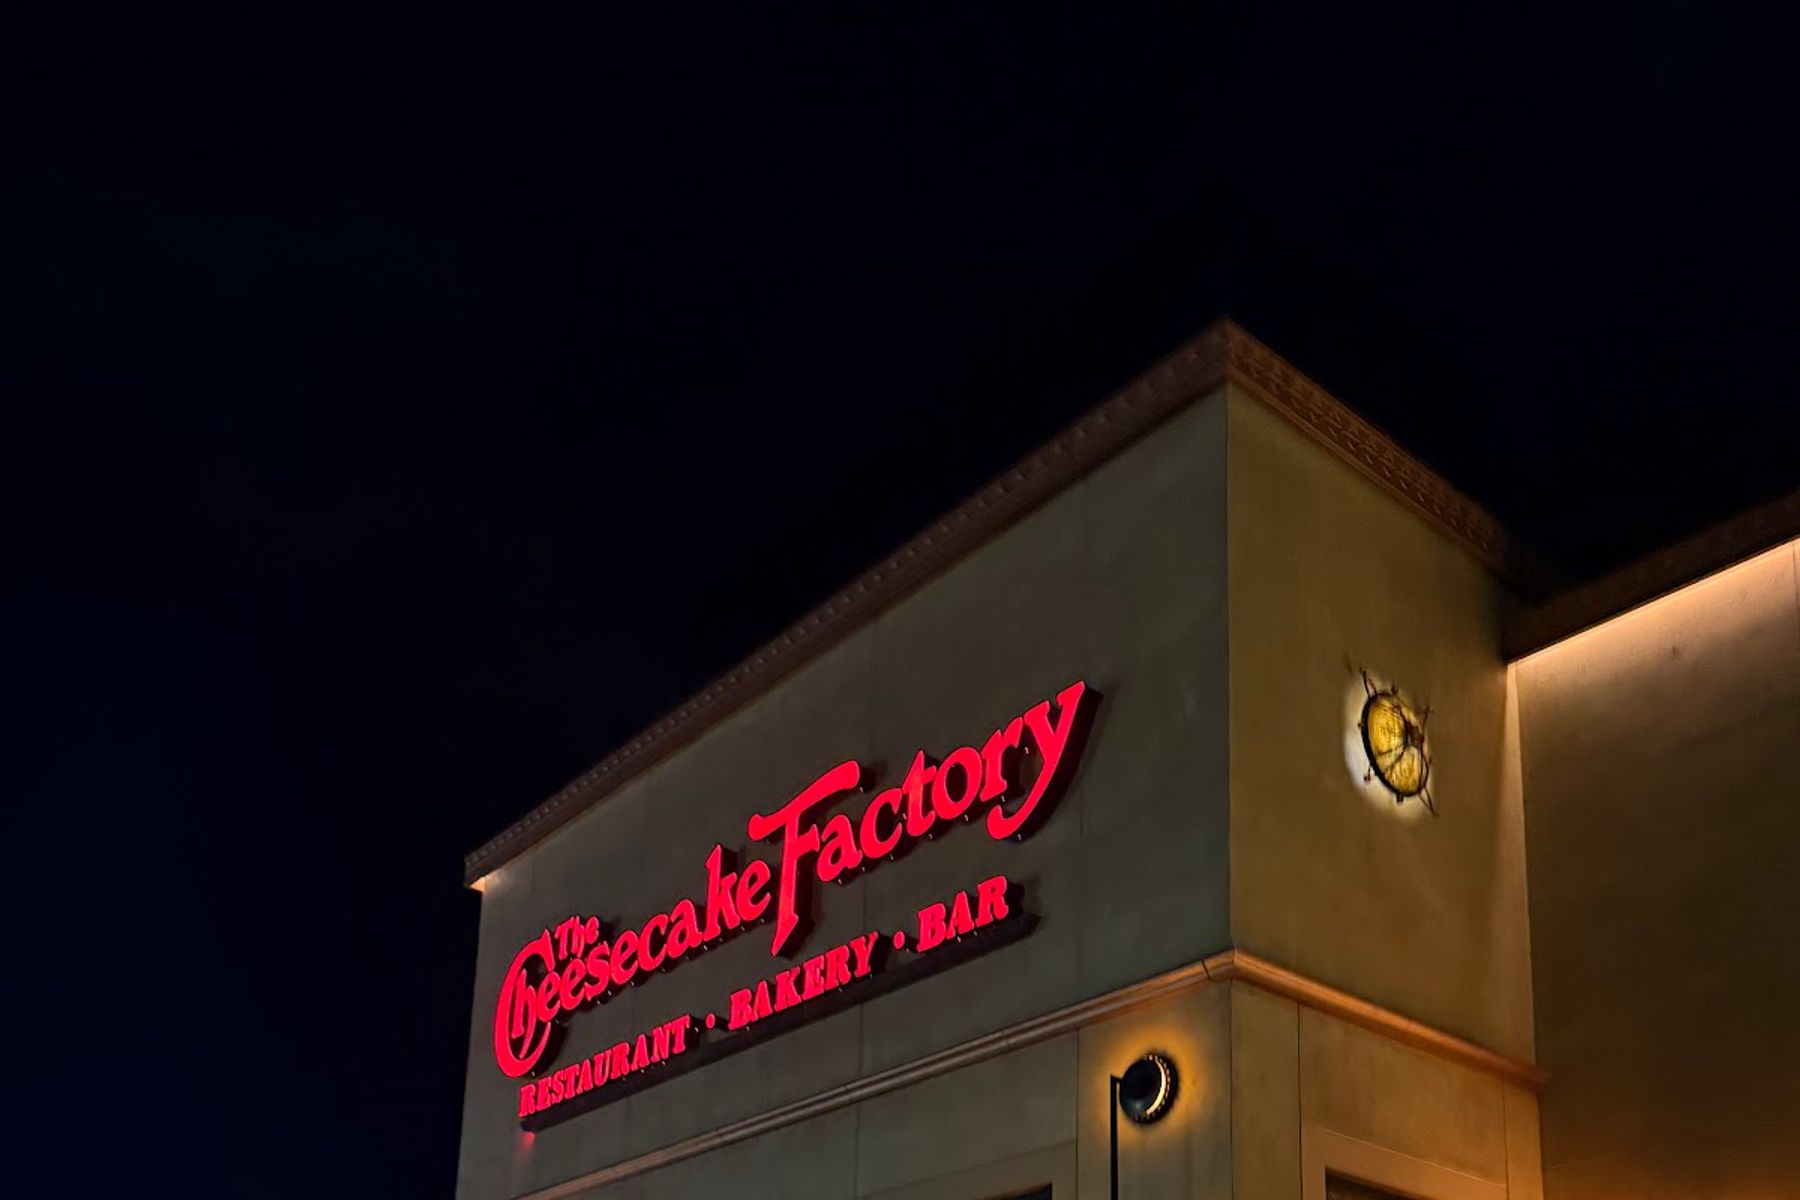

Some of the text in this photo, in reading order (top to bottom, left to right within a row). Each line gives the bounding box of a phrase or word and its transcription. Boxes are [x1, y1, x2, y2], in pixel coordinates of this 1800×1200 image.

[493, 681, 1085, 1079] Cheesecake Factory
[518, 875, 1009, 1118] RESTAURANT BAKERY BAR
[554, 915, 600, 961] The
